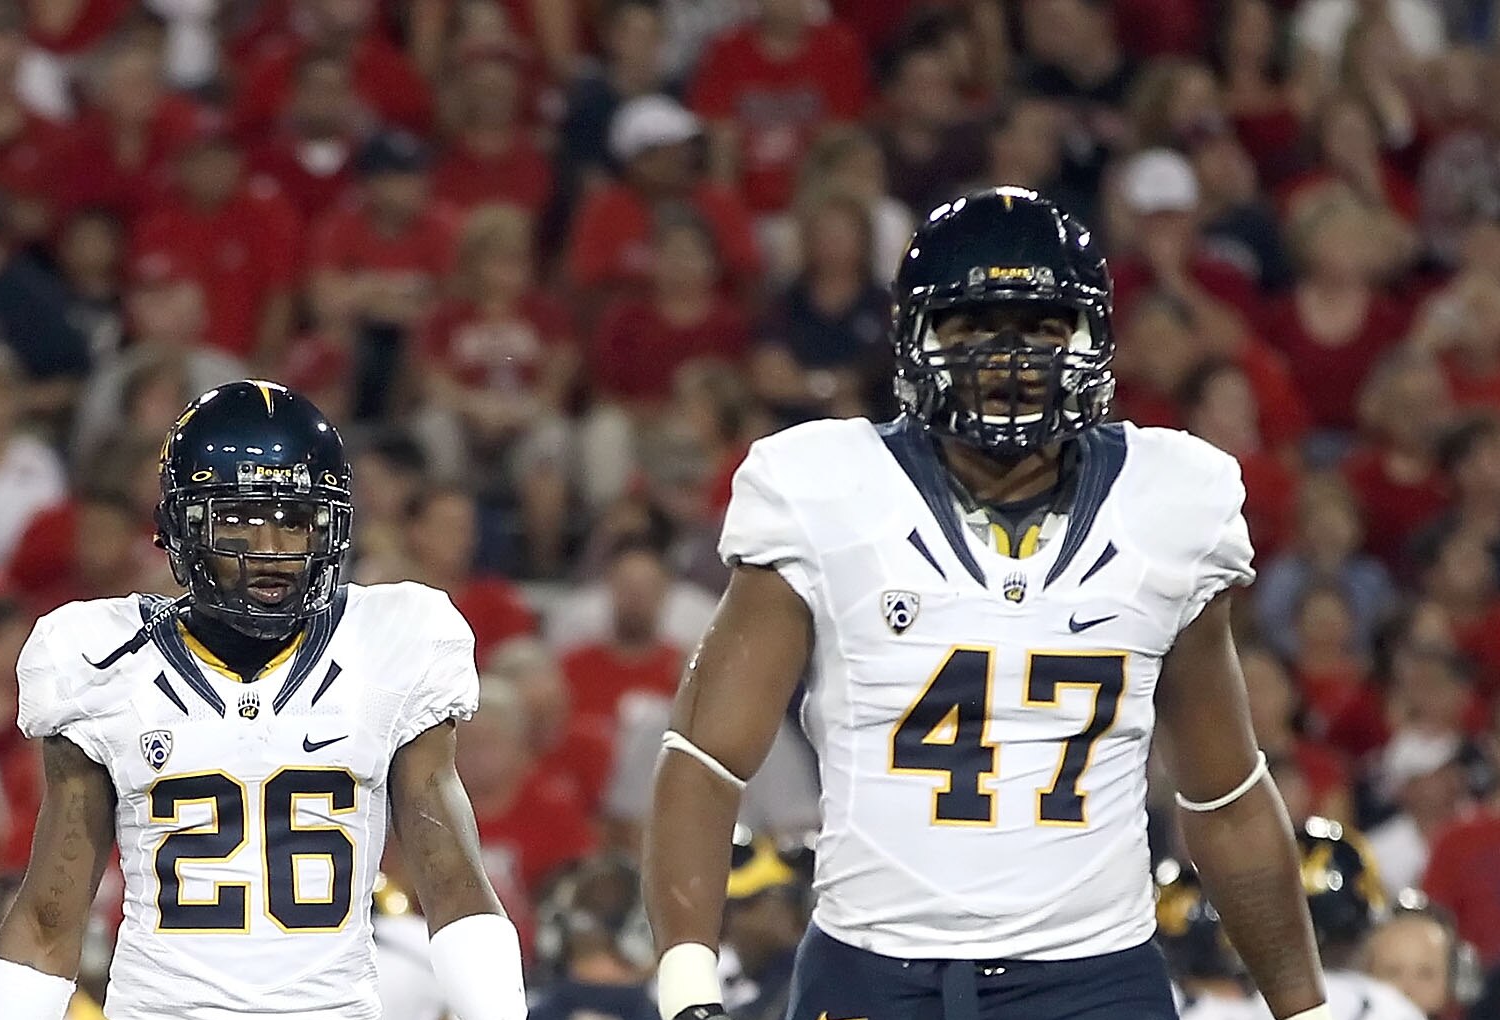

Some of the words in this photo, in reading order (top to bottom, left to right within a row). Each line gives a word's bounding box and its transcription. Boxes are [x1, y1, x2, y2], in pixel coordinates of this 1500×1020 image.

[256, 466, 292, 478] Bears
[141, 731, 172, 757] PAC
[889, 645, 1128, 828] 47
[150, 747, 167, 764] 10
[148, 766, 358, 934] 26
